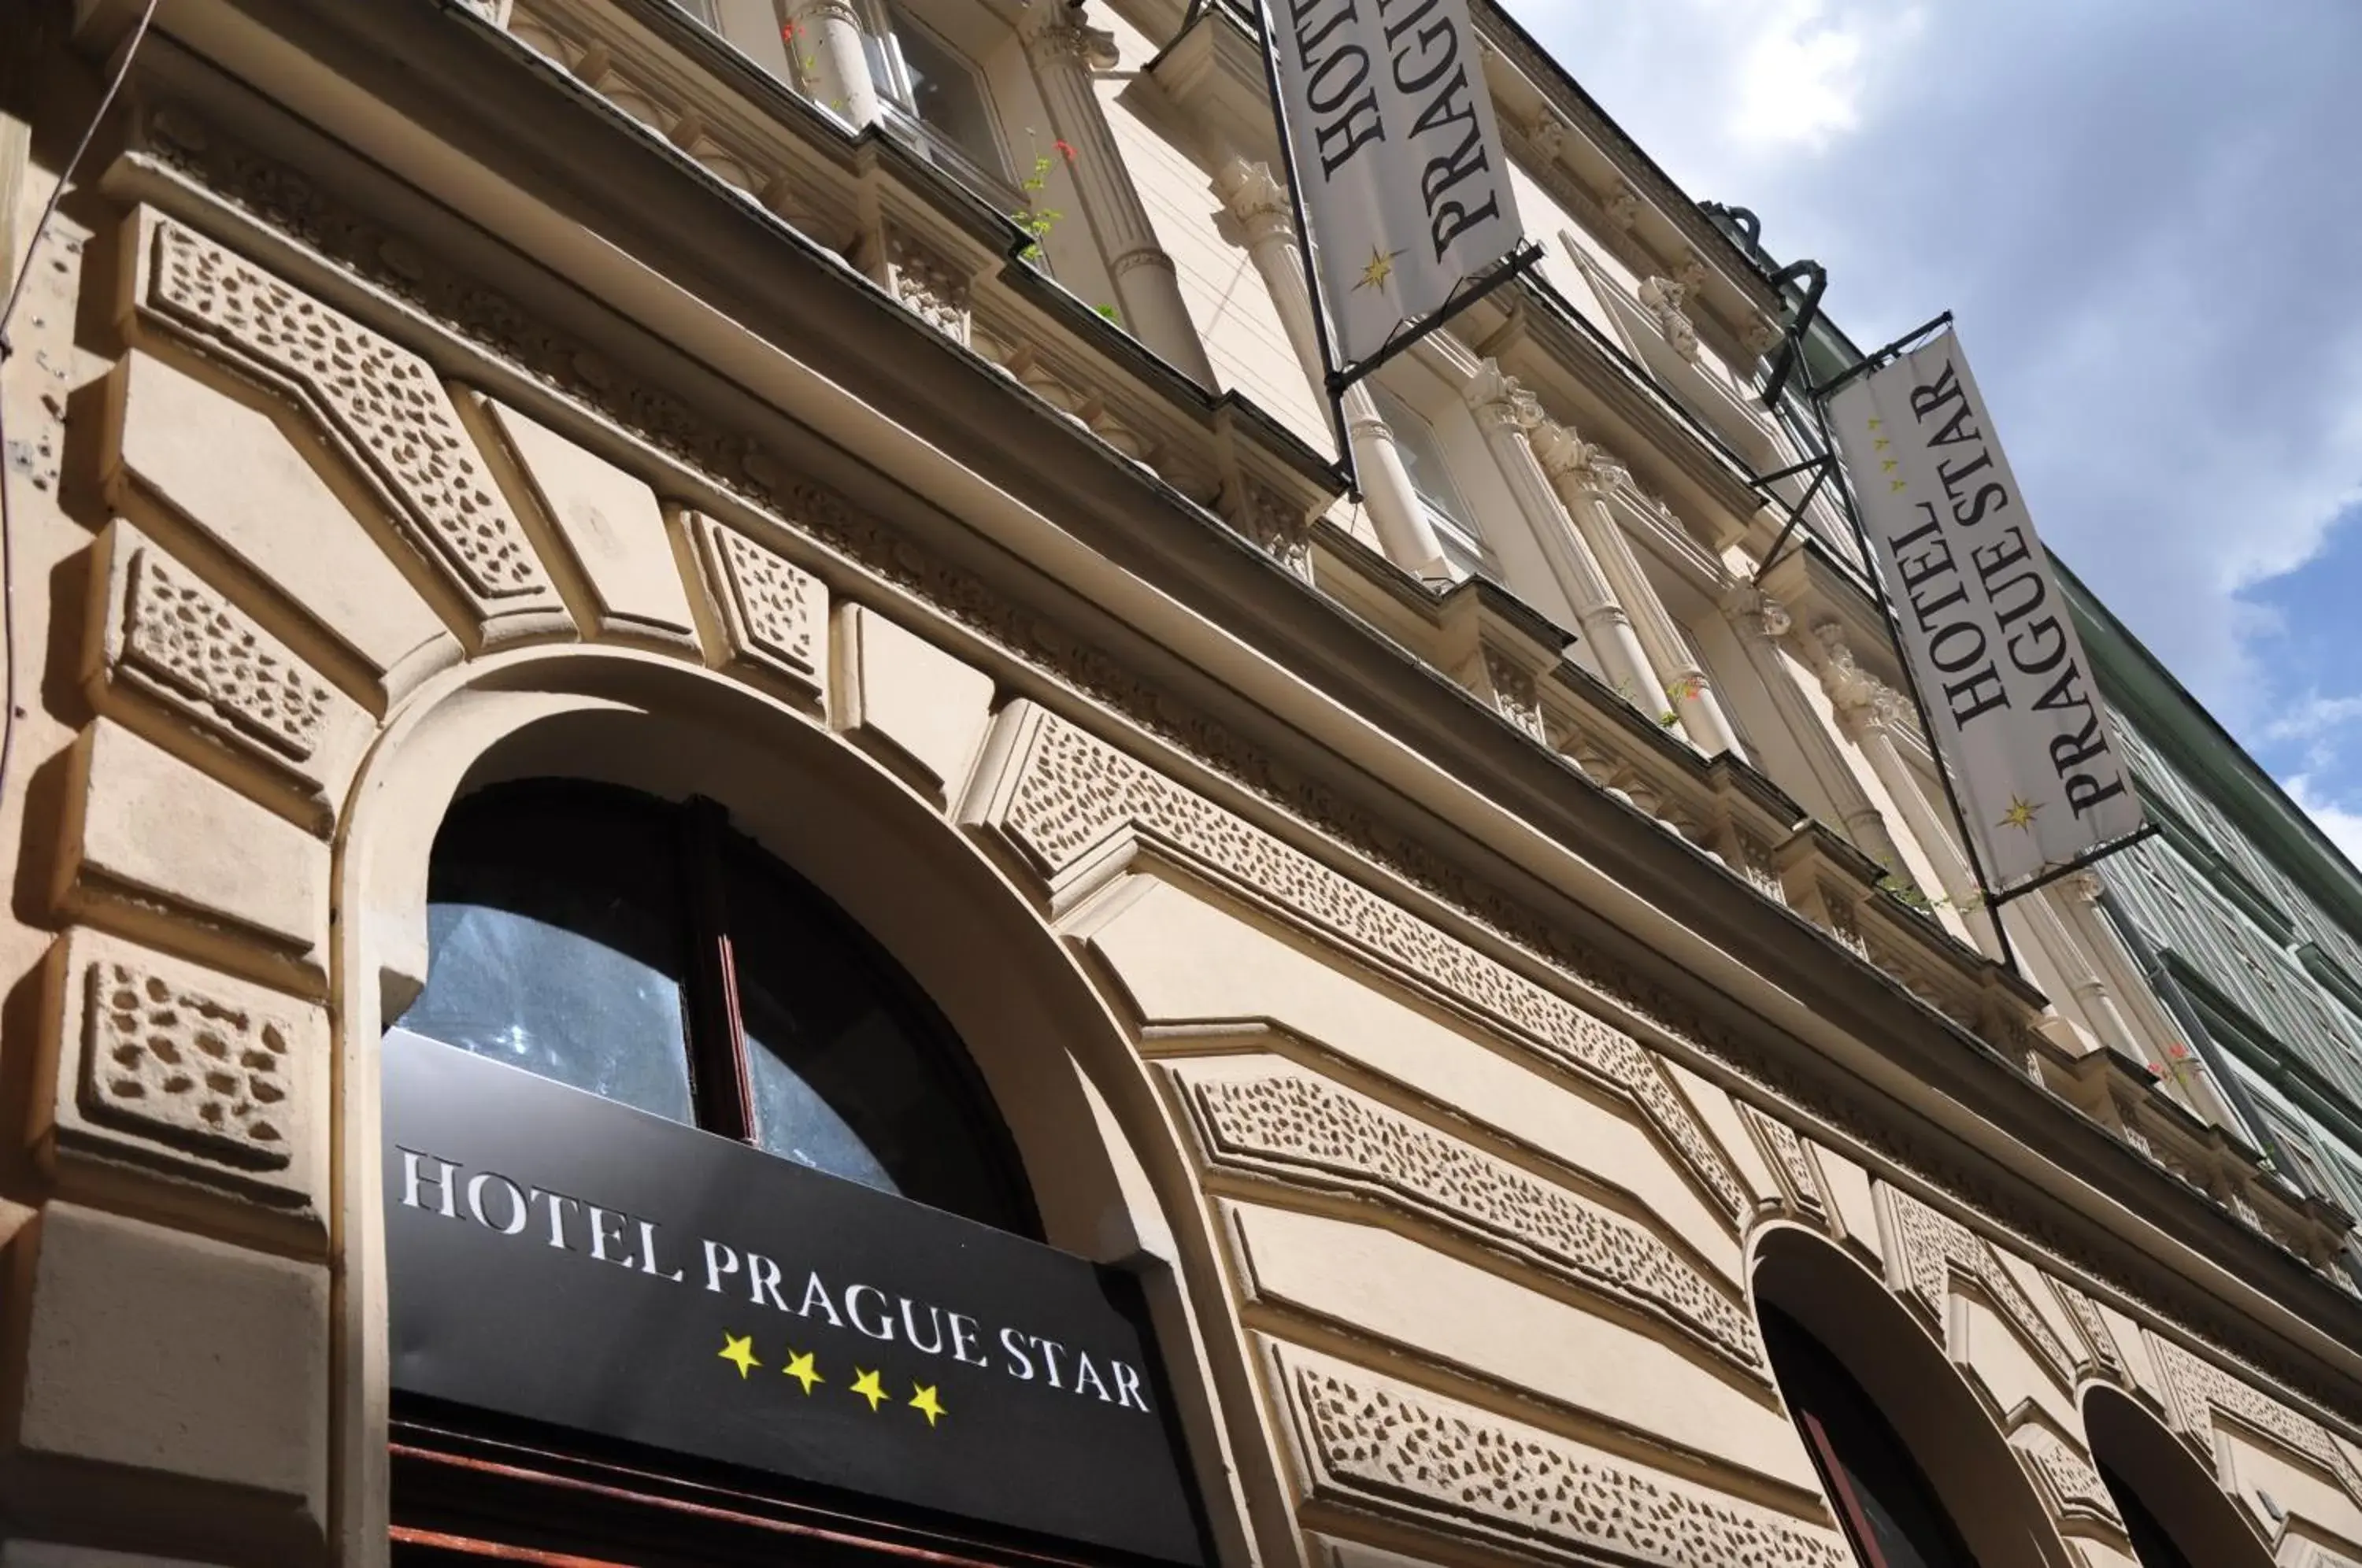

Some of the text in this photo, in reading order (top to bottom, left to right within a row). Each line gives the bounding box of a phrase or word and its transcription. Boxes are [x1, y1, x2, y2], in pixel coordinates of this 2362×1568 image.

[1887, 501, 2012, 731] HOTEL
[1909, 358, 2127, 819] PRAGUE STAR
[395, 1145, 1151, 1413] HOTEL PRAGUE STAR
